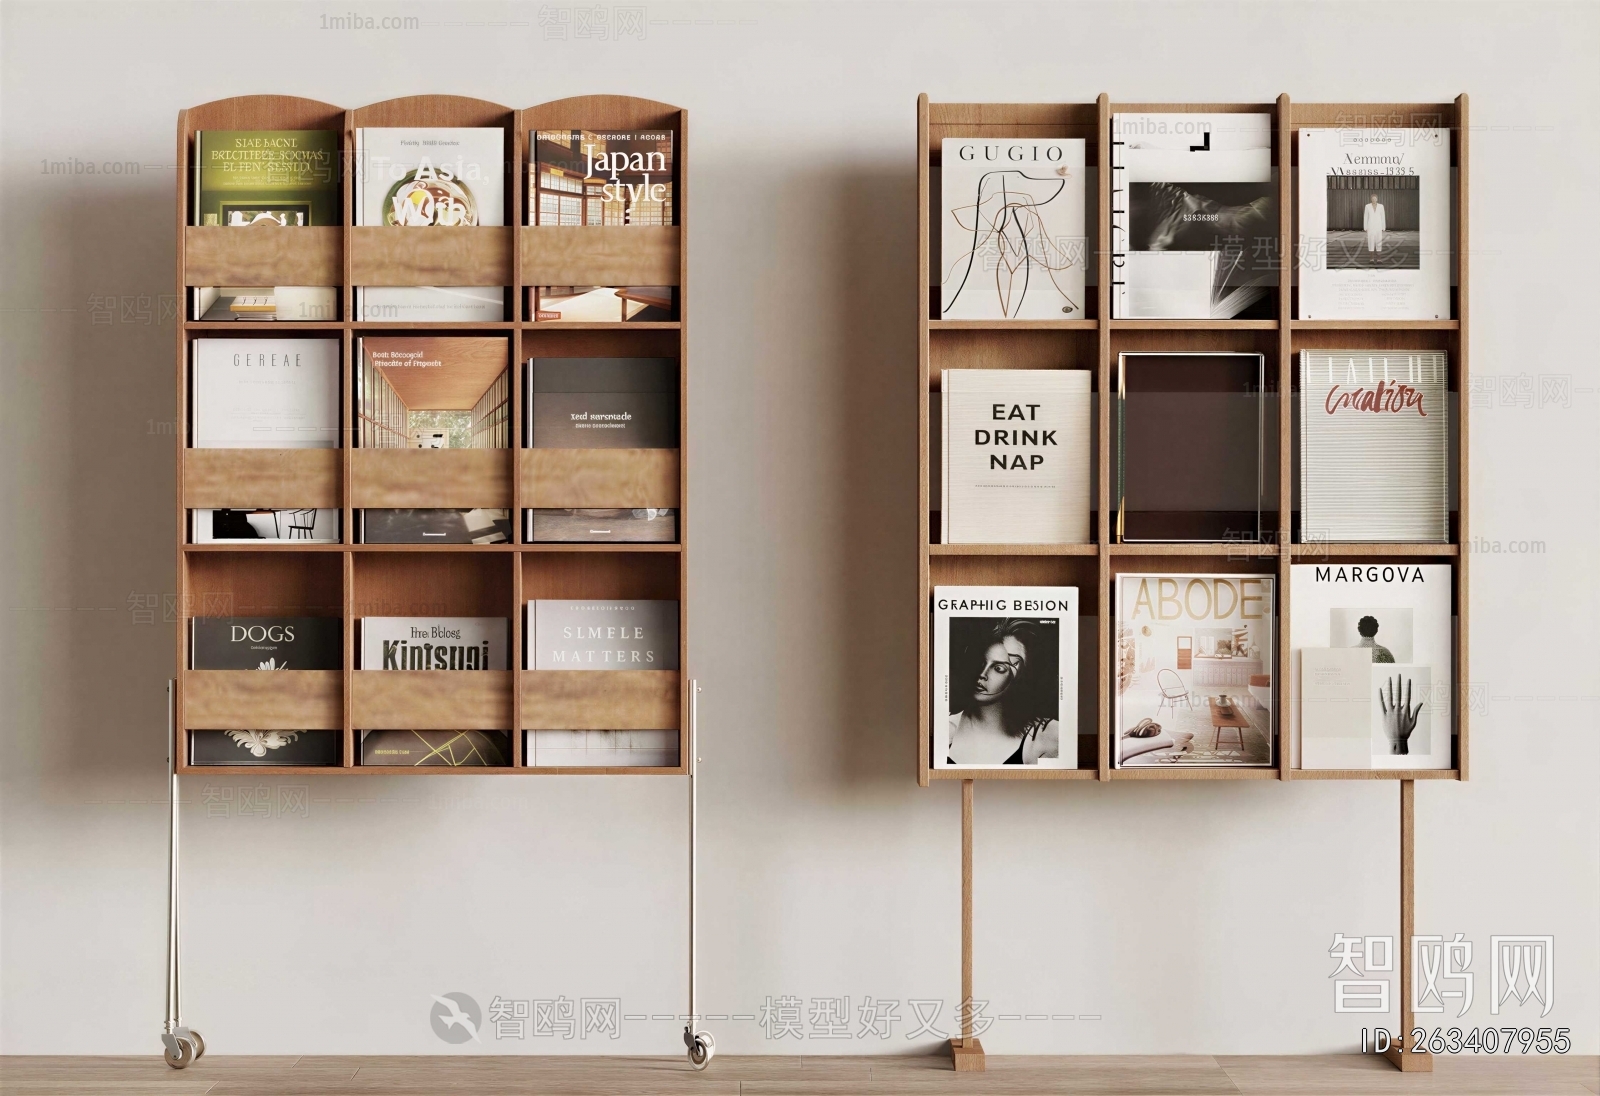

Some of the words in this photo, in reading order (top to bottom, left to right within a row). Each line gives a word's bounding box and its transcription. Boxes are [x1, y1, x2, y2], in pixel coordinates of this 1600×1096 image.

[959, 144, 1063, 162] GUGIO
[583, 143, 667, 181] Japan
[600, 172, 667, 206] style
[233, 353, 302, 367] GEREAE
[992, 403, 1041, 421] EAT
[975, 429, 1058, 446] DRINK
[990, 454, 1045, 471] NAP
[1315, 566, 1425, 583] MARGOVA
[1130, 577, 1263, 621] ABODE
[230, 625, 295, 642] DOGS
[552, 650, 655, 663] MATTERS
